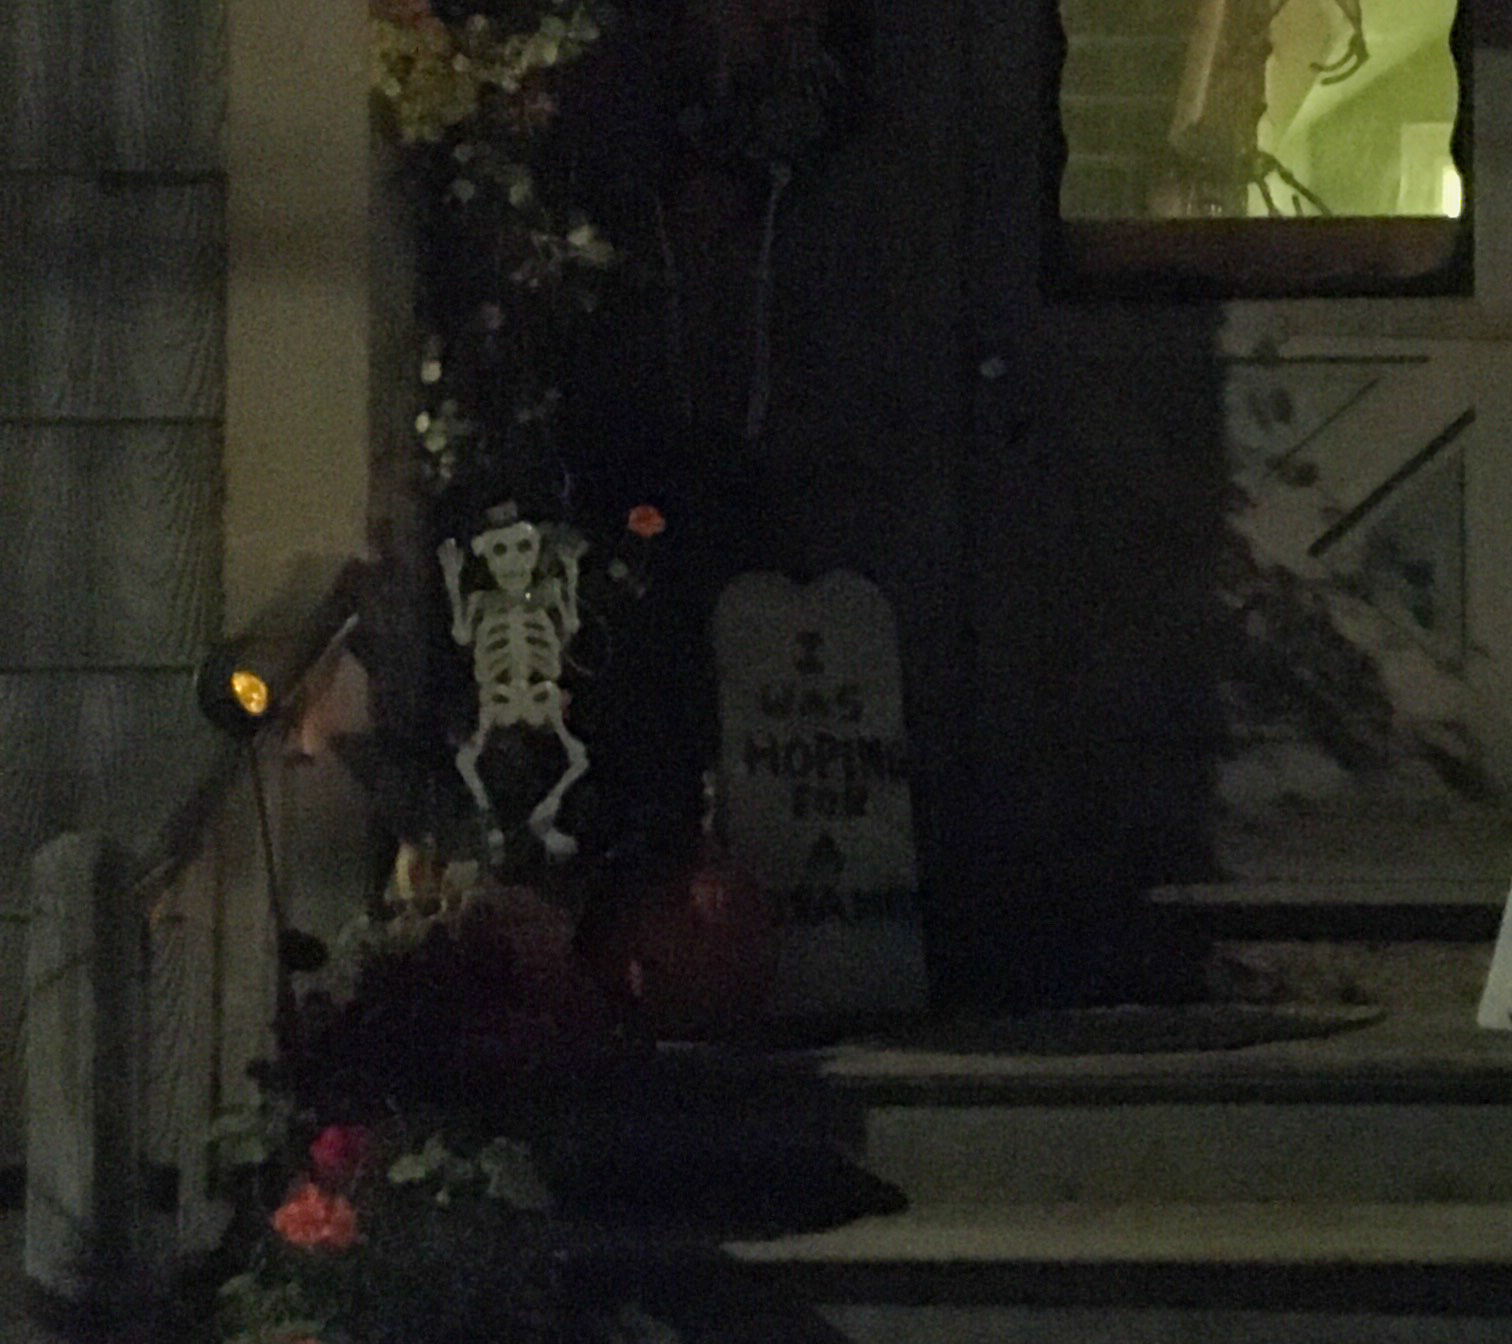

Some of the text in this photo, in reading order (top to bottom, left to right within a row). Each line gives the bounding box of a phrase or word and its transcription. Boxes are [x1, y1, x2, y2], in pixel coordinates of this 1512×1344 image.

[793, 630, 825, 674] I
[761, 683, 865, 723] WAS
[744, 731, 909, 780] HOPING
[791, 783, 869, 821] FOR
[804, 832, 846, 878] A
